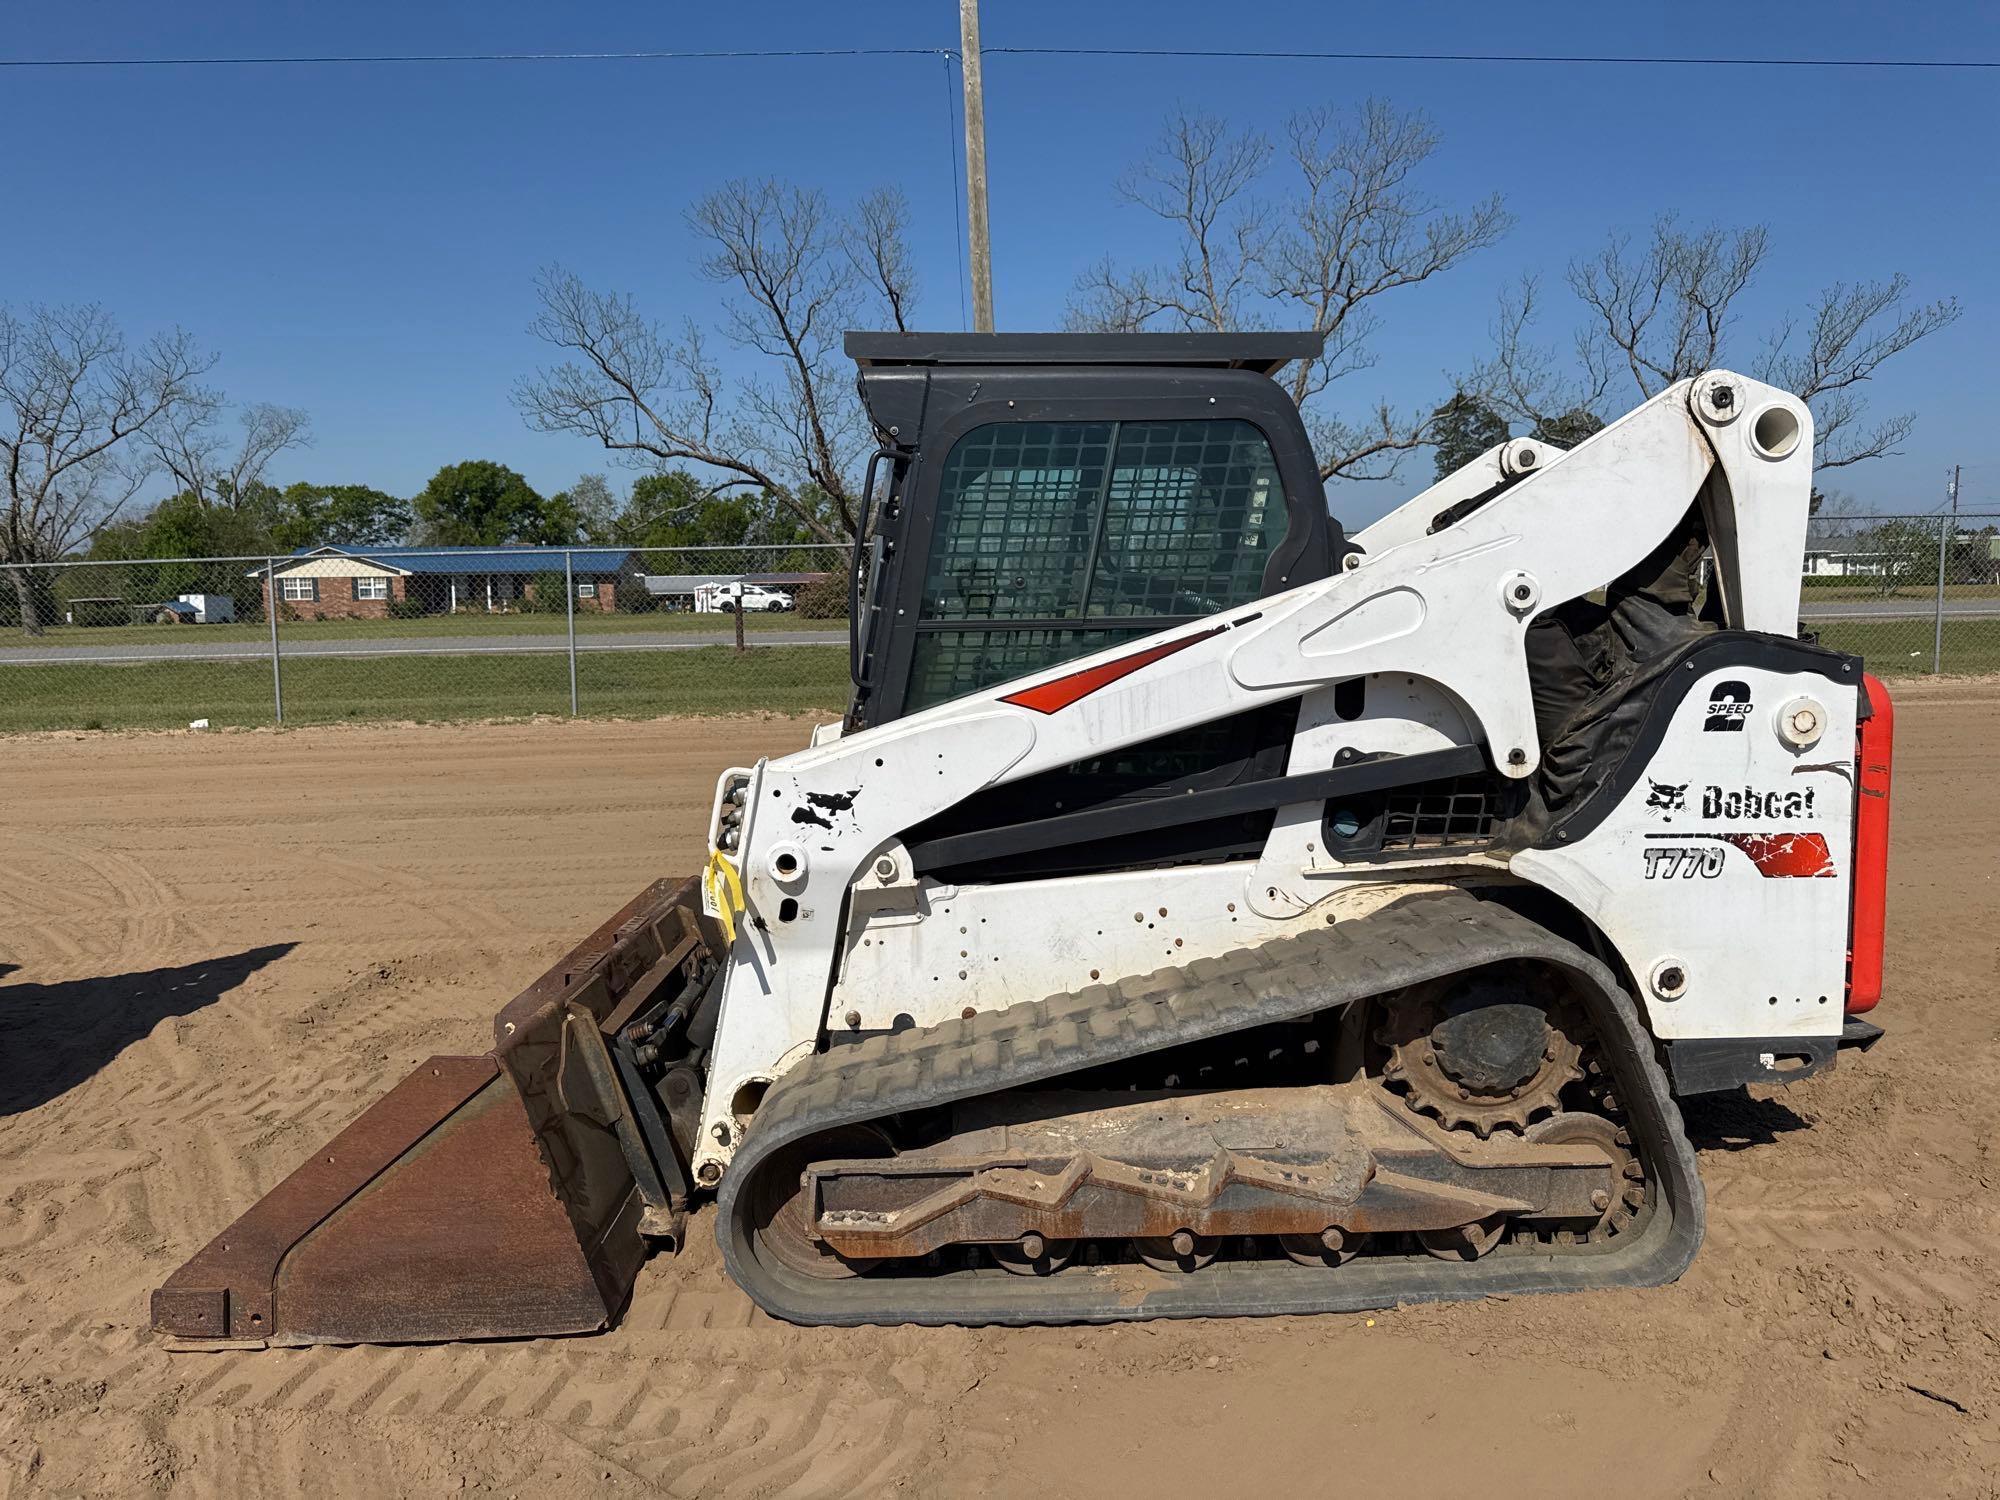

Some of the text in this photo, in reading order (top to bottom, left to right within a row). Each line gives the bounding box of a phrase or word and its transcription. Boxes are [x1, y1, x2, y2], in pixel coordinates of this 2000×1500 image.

[1703, 680, 1751, 732] 2
[1706, 703, 1754, 714] SPEED
[1702, 785, 1815, 819] Bobcat
[1643, 847, 1726, 879] T770
